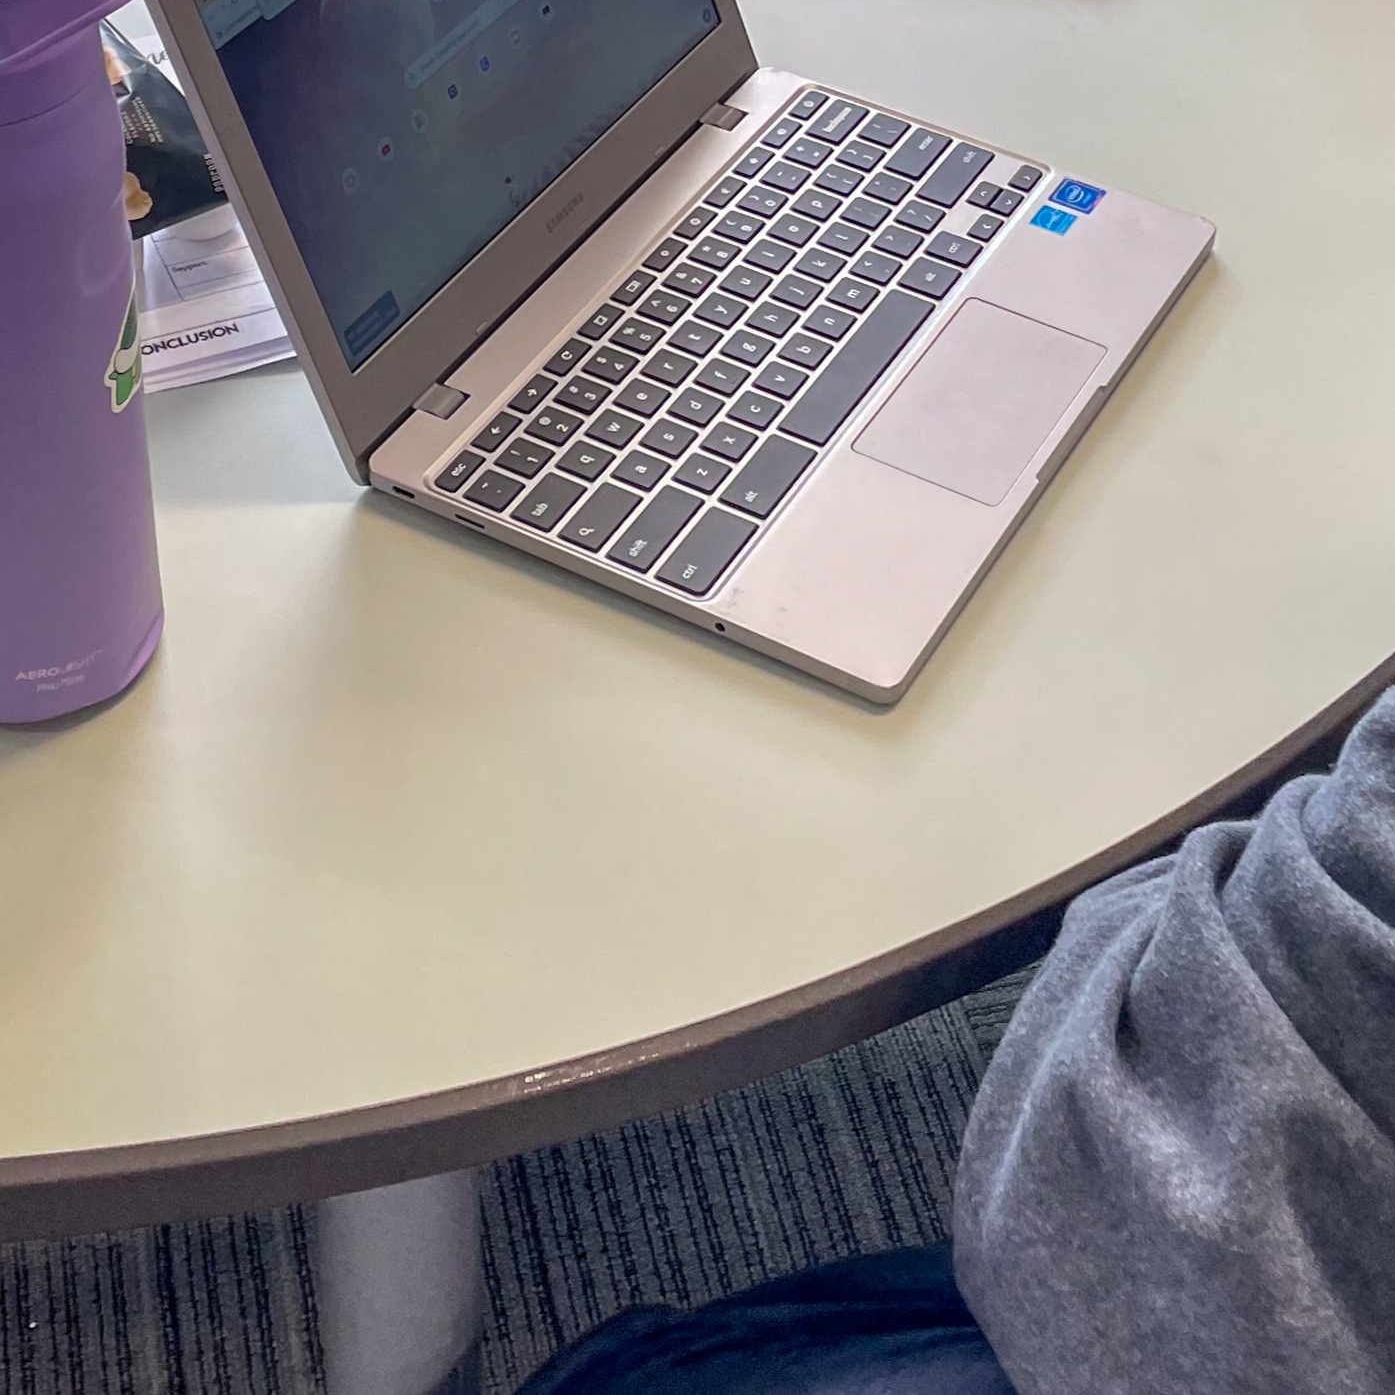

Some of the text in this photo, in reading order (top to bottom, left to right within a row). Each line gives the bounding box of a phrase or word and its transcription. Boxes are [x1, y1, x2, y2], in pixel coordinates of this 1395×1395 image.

[811, 200, 823, 209] p
[545, 193, 586, 234] SAMSUNG
[788, 225, 800, 233] o
[716, 250, 729, 259] 8
[811, 260, 827, 268] k
[690, 277, 703, 285] 7
[739, 277, 752, 285] u
[846, 288, 861, 299] m
[666, 305, 678, 313] 6
[714, 304, 728, 315] y
[763, 314, 779, 323] h
[823, 317, 836, 326] n
[140, 322, 240, 356] ONCLUSION
[639, 333, 652, 342] 5
[688, 333, 701, 341] t
[742, 342, 757, 352] g
[796, 345, 811, 354] b
[614, 362, 625, 371] 4
[663, 362, 674, 370] r
[714, 370, 727, 380] f
[774, 374, 786, 382] v
[584, 392, 597, 401] 3
[636, 392, 648, 401] e
[690, 400, 702, 410] d
[750, 405, 761, 413] c
[556, 423, 569, 433] 2
[606, 421, 621, 432] w
[663, 432, 675, 441] s
[722, 436, 736, 445] x
[579, 454, 595, 464] q
[450, 461, 467, 478] esc
[634, 465, 648, 474] a
[696, 468, 708, 477] z
[744, 490, 758, 503] alt
[531, 503, 549, 517] tab
[628, 537, 647, 558] shift
[682, 563, 698, 579] ctrl
